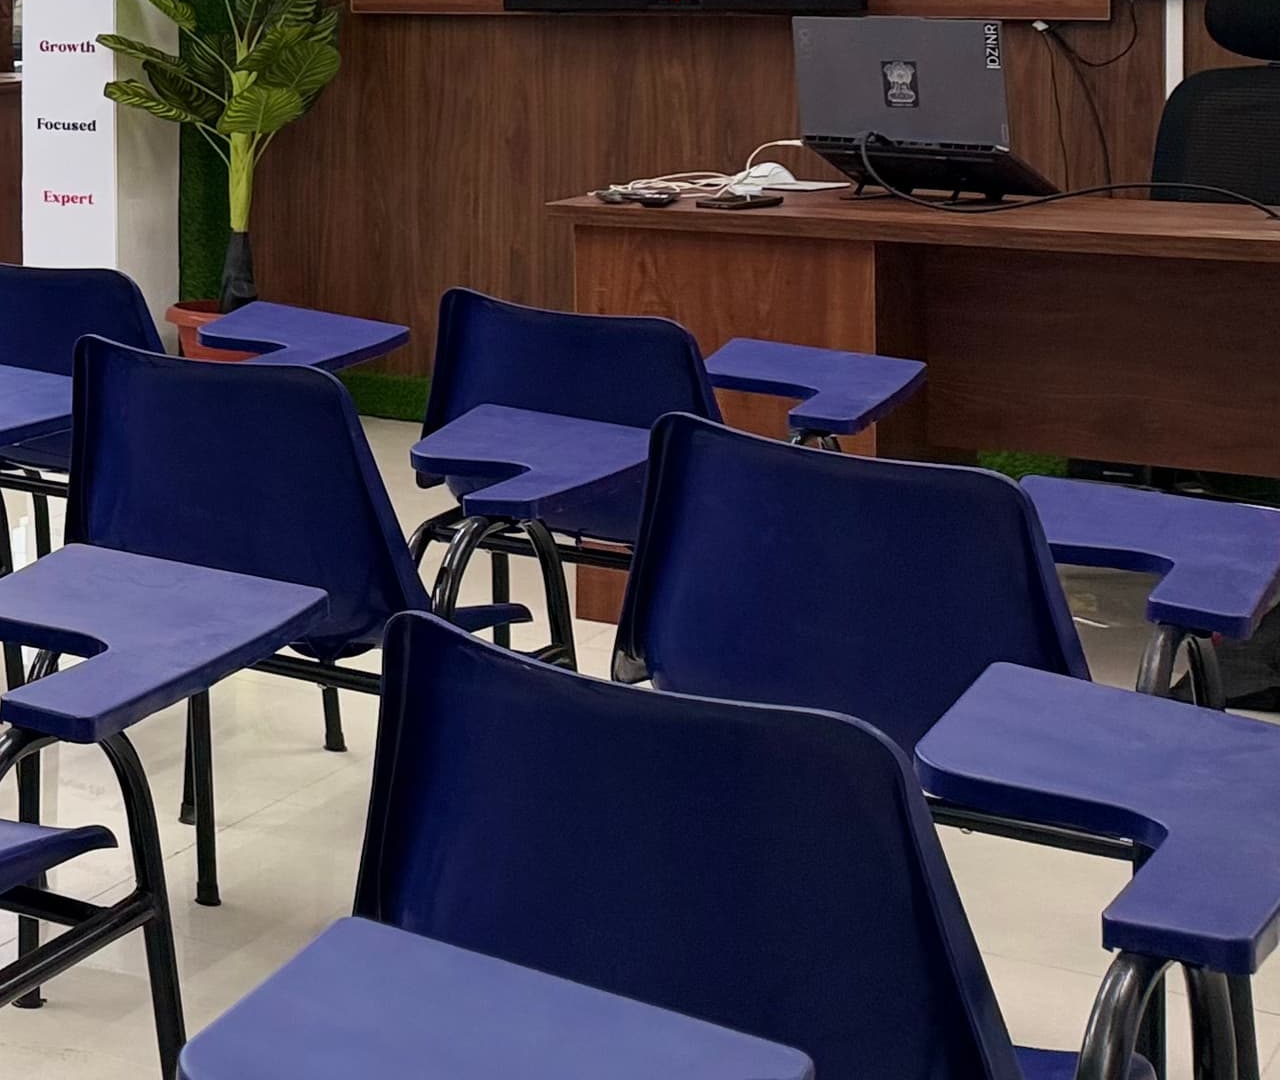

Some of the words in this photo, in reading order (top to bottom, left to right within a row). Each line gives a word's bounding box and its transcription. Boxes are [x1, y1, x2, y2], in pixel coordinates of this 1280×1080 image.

[39, 39, 96, 54] Growth
[37, 117, 97, 132] Focused
[43, 189, 94, 206] Expert
